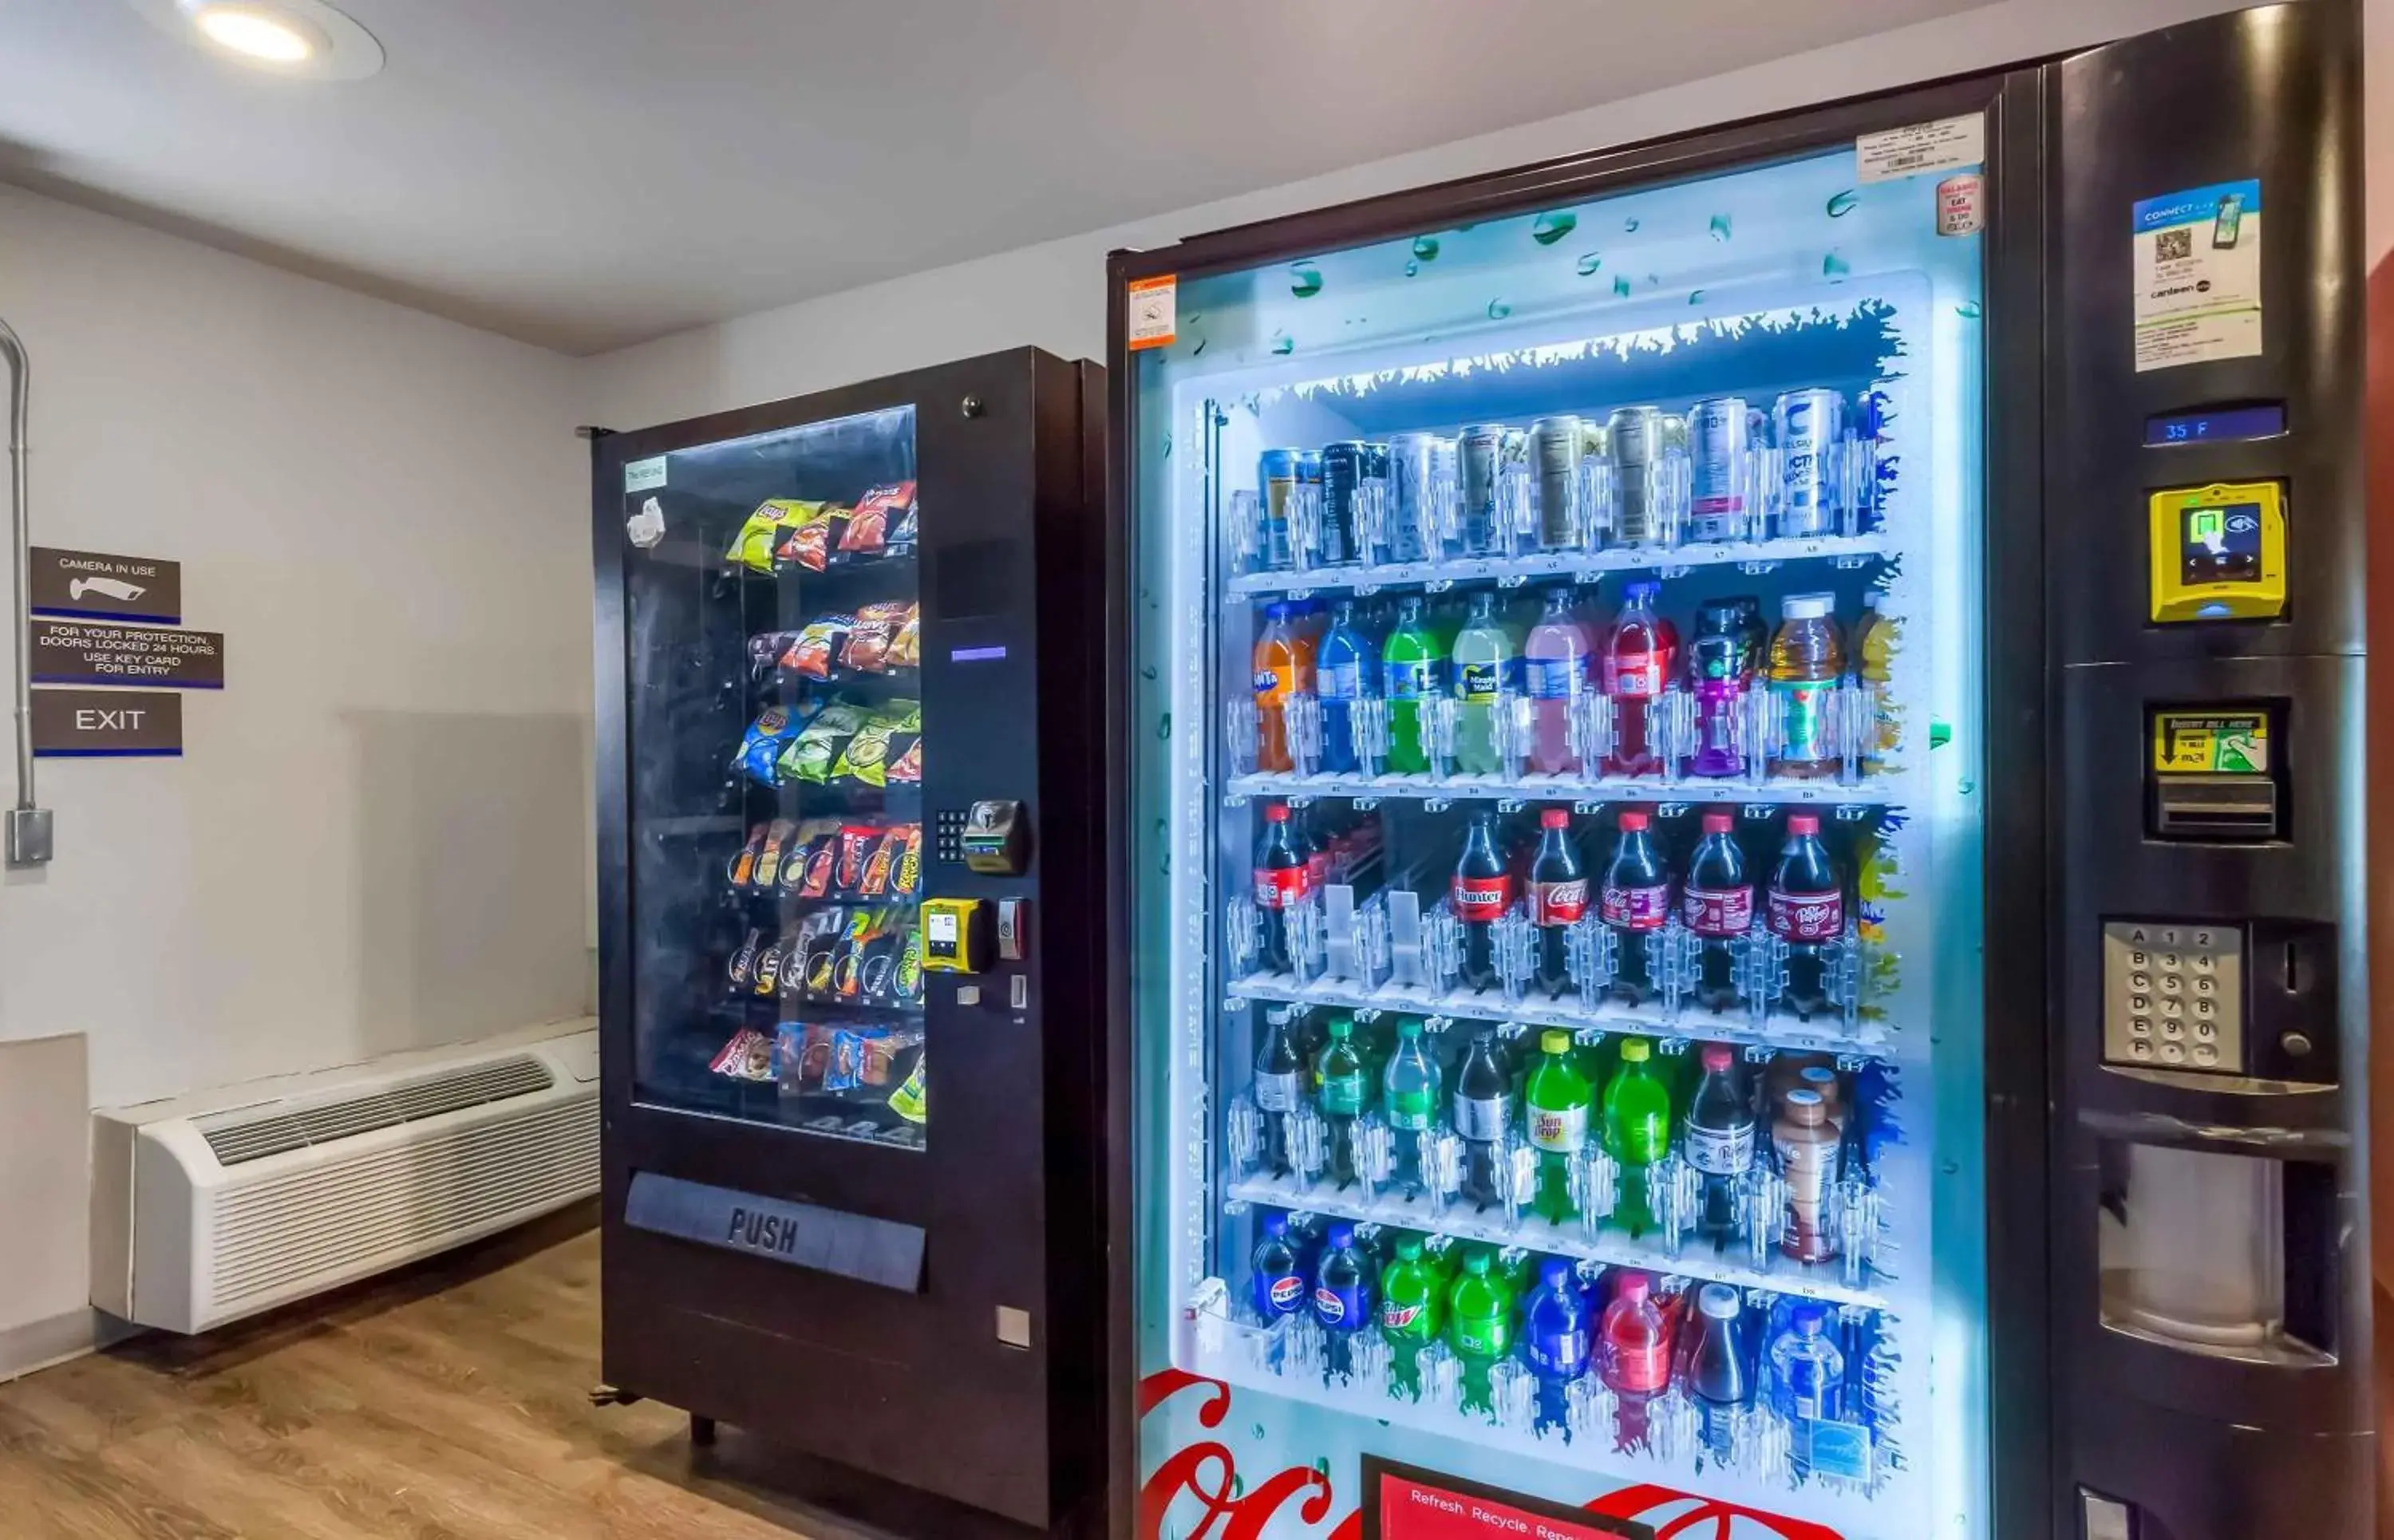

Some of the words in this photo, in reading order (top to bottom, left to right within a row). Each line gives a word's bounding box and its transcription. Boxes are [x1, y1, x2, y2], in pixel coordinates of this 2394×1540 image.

[2167, 424, 2187, 438] 35
[2198, 422, 2207, 435] F
[60, 558, 112, 572] CAMERA
[116, 564, 128, 574] IN
[132, 565, 156, 577] USE
[50, 626, 79, 637] FOR
[84, 629, 121, 639] YOUR
[41, 637, 92, 649] DOORS
[96, 640, 149, 652] LOCKED
[152, 643, 167, 653] 24
[84, 653, 111, 663] USE
[116, 654, 141, 665] KEY
[145, 656, 181, 667] CARD
[96, 663, 124, 673] FOR
[128, 665, 170, 676] ENTRY
[76, 709, 146, 730] EXIT
[1456, 886, 1502, 904] Hunter
[2132, 930, 2144, 942] A
[2167, 933, 2175, 942] 1
[2198, 933, 2209, 945] 2
[2133, 952, 2144, 964] B
[2166, 954, 2176, 965] 3
[2198, 956, 2208, 967] 4
[2133, 975, 2145, 986] C
[2167, 978, 2176, 989] 5
[2199, 979, 2208, 990] 6
[2133, 997, 2145, 1009] D
[2167, 1001, 2176, 1011] 7
[2200, 1001, 2209, 1013] 8
[2135, 1020, 2144, 1032] E
[2167, 1023, 2176, 1033] 9
[2199, 1024, 2210, 1036] 0
[2135, 1042, 2145, 1052] F
[1536, 1113, 1562, 1127] Sun
[1535, 1123, 1560, 1139] Drop
[727, 1207, 797, 1254] PUSH
[1472, 1507, 1531, 1534] Recycle.
